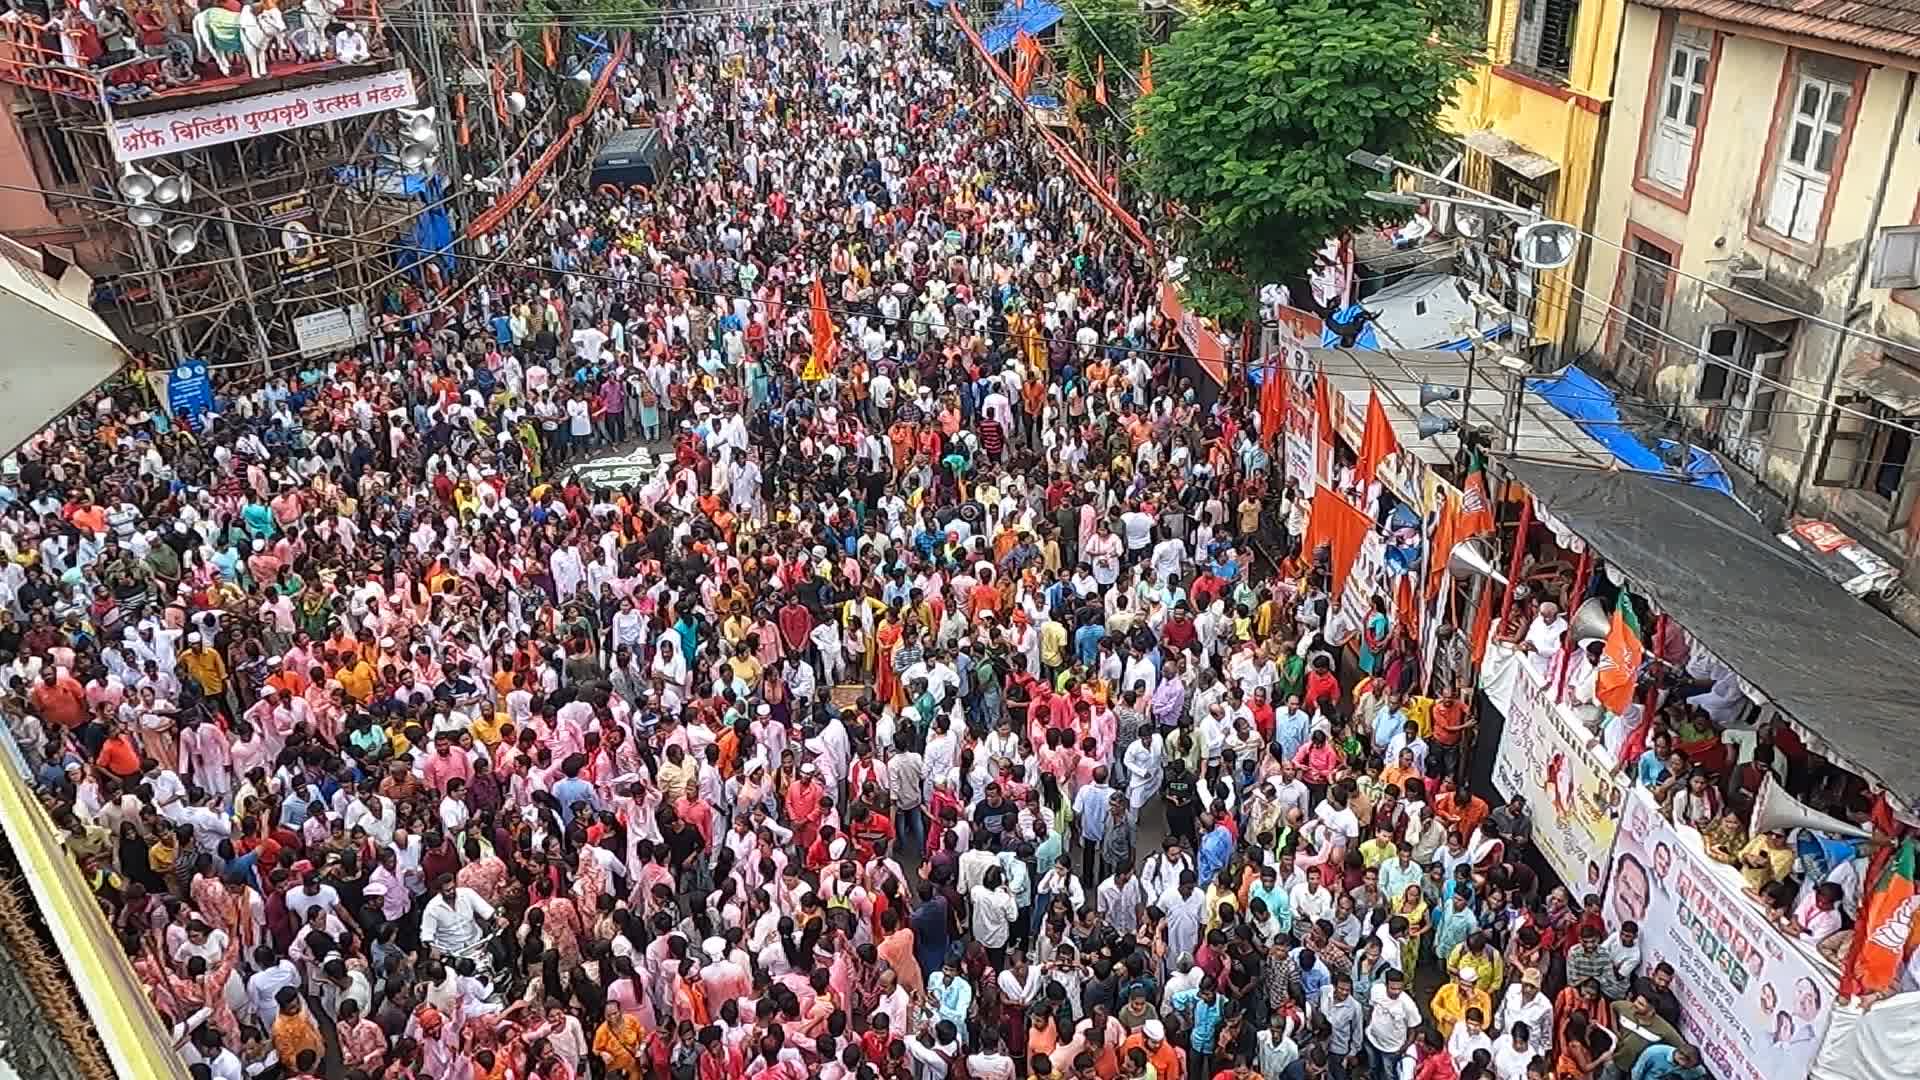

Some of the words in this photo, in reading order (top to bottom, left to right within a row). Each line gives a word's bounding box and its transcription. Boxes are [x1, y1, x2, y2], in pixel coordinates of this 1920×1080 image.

[122, 126, 165, 152] श्रॉफ
[170, 113, 239, 143] बिल्डिंग
[313, 91, 361, 114] उत्सव
[366, 84, 407, 105] मंडळ
